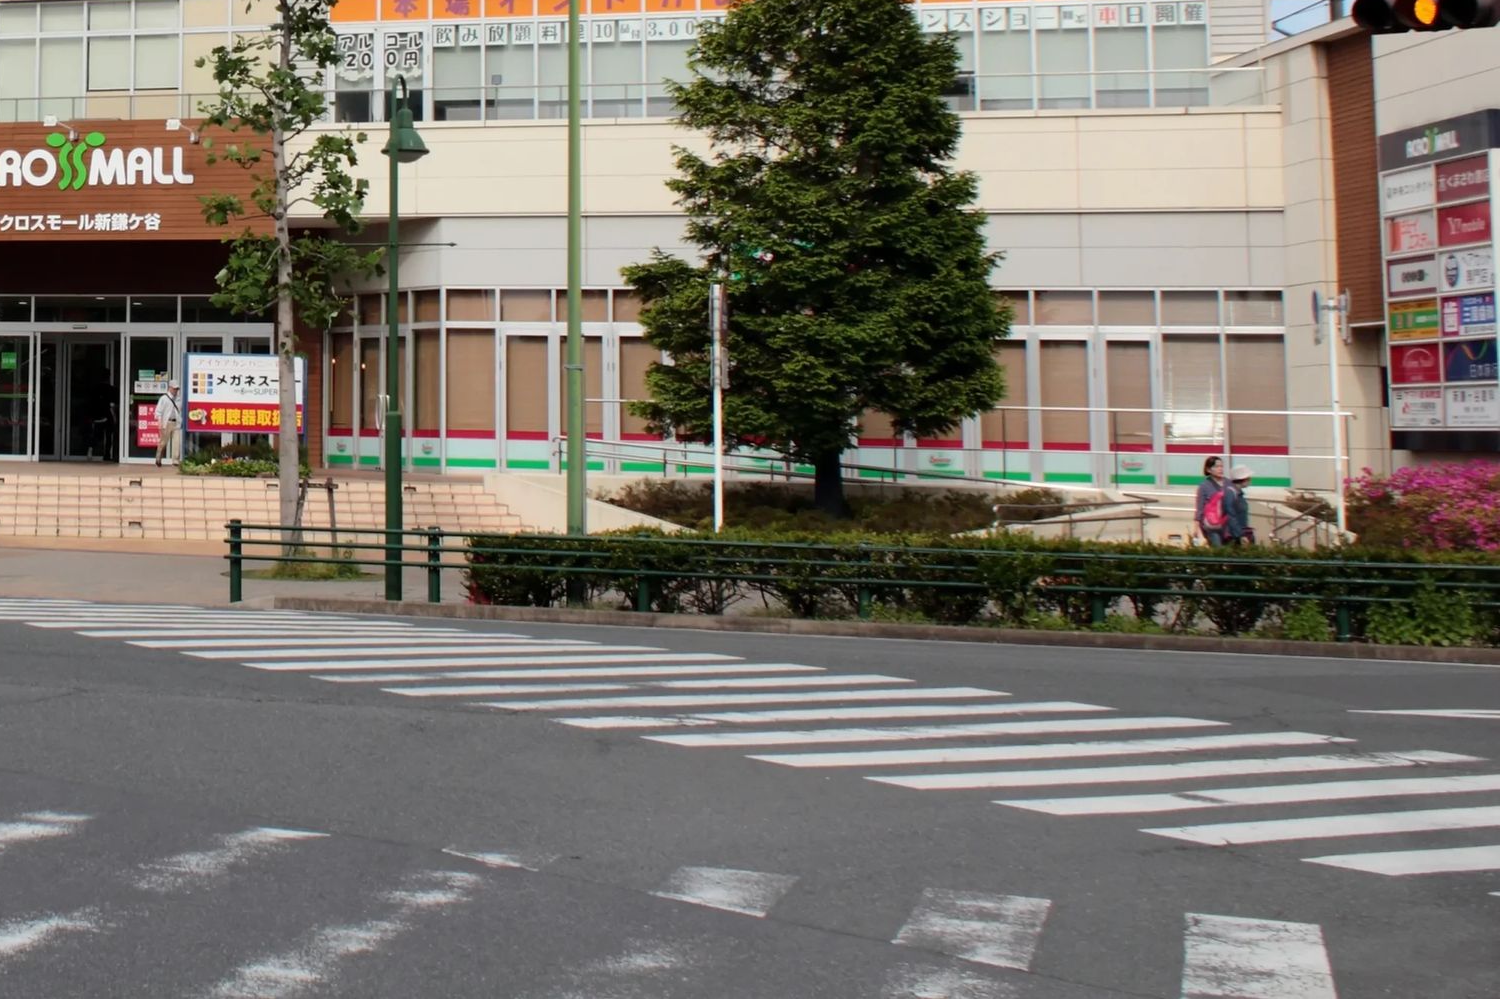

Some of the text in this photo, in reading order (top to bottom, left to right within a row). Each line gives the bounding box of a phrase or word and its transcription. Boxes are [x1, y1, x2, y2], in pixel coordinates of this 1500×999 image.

[346, 51, 418, 67] 200円
[216, 375, 301, 386] メガネスーー
